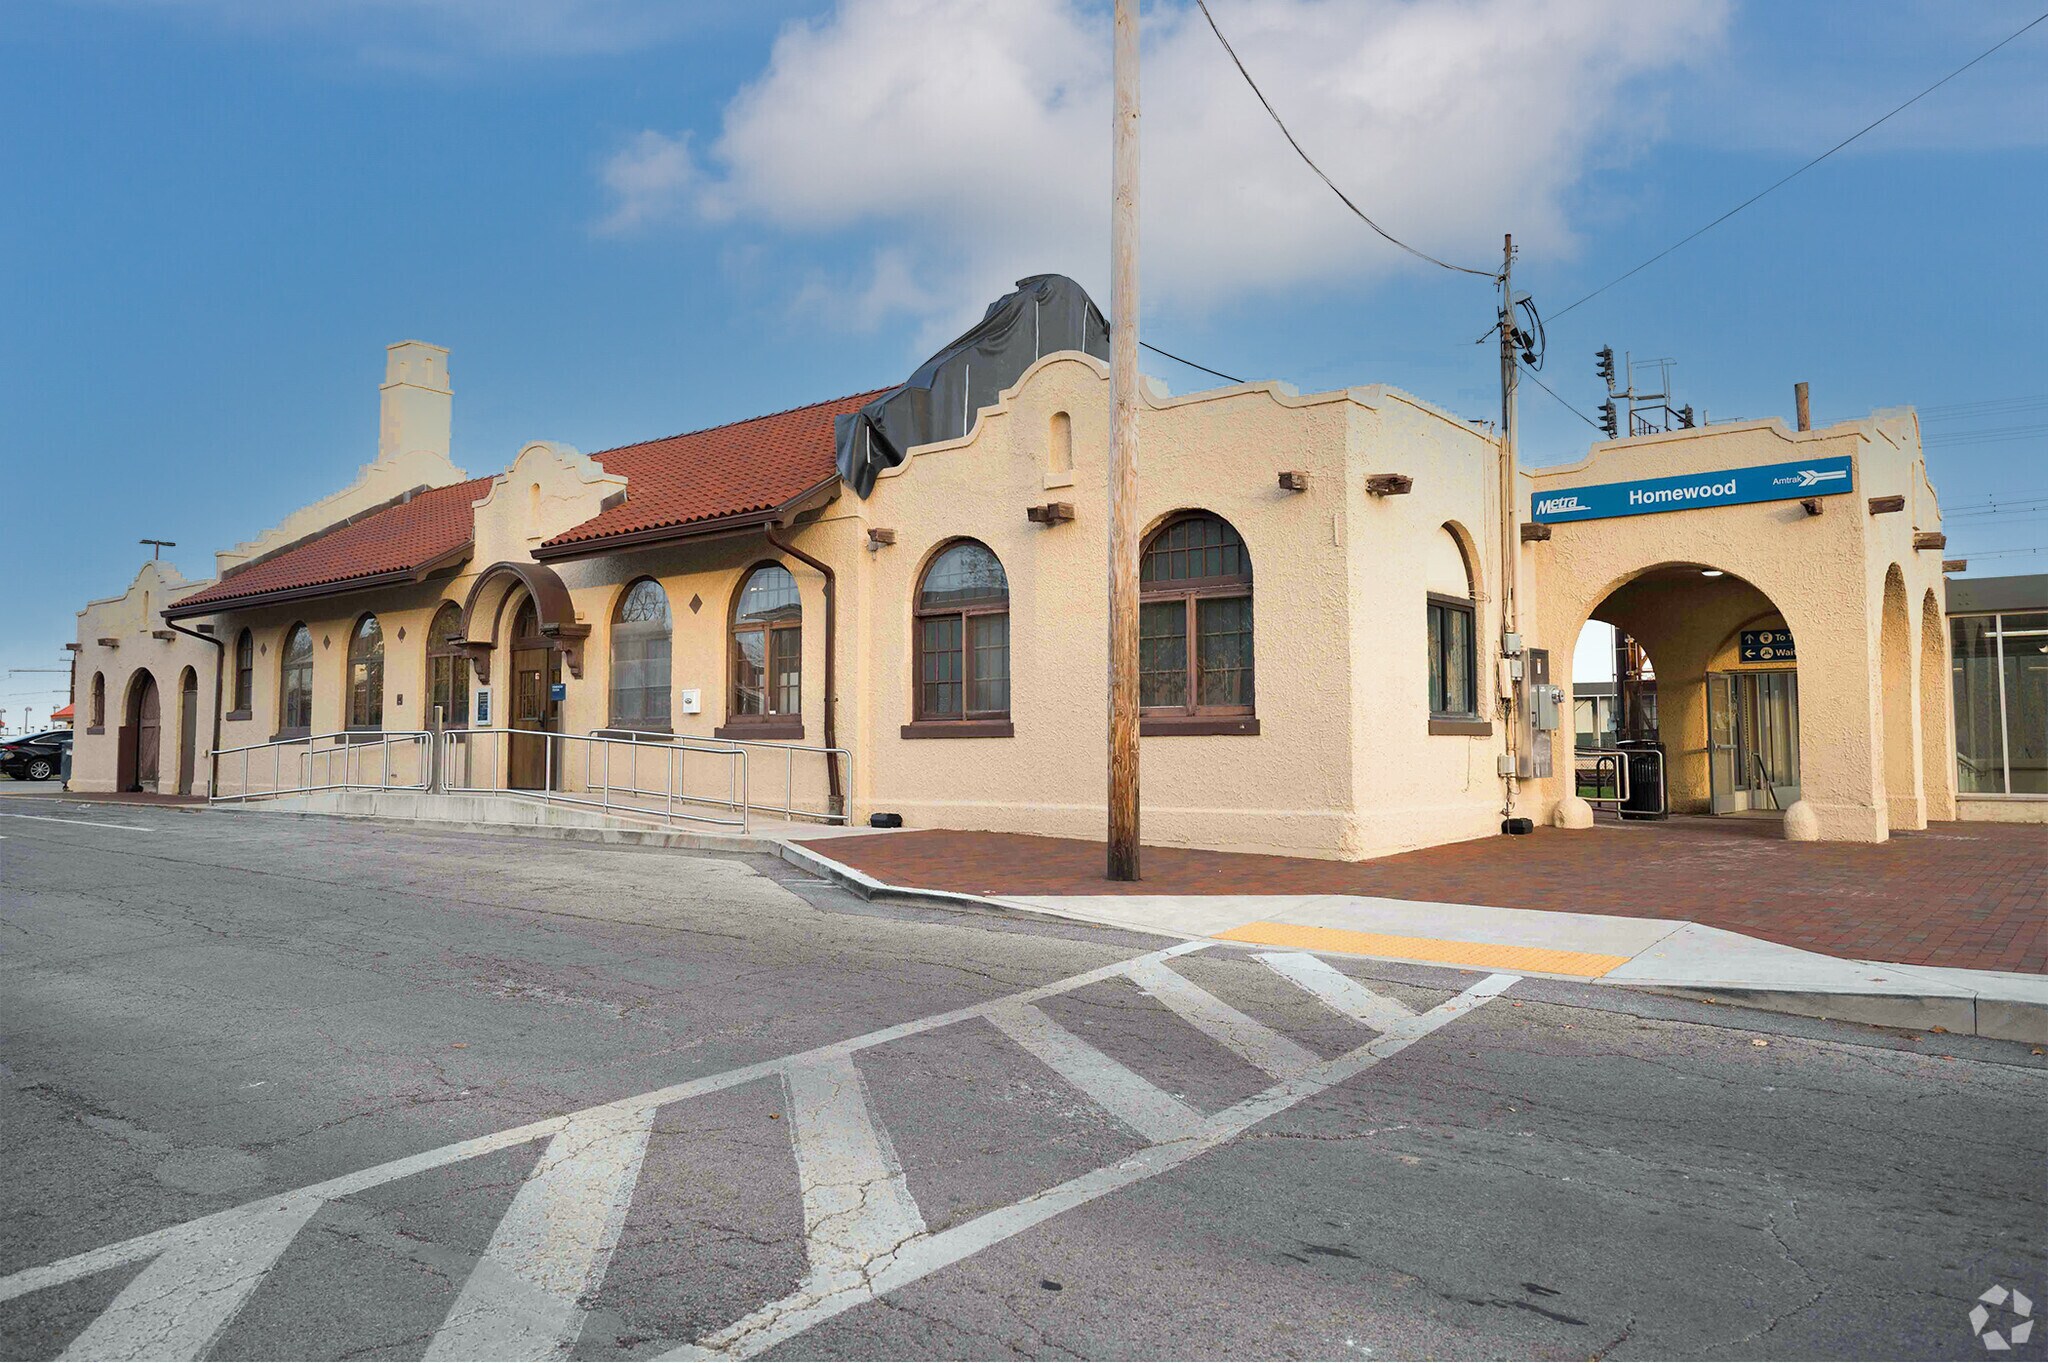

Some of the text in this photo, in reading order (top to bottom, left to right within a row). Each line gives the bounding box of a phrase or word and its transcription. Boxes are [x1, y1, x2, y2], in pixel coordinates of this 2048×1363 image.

[1772, 475, 1803, 486] Amtrak
[1629, 479, 1737, 505] Homewood
[1535, 496, 1581, 515] Metra
[1775, 633, 1786, 642] To
